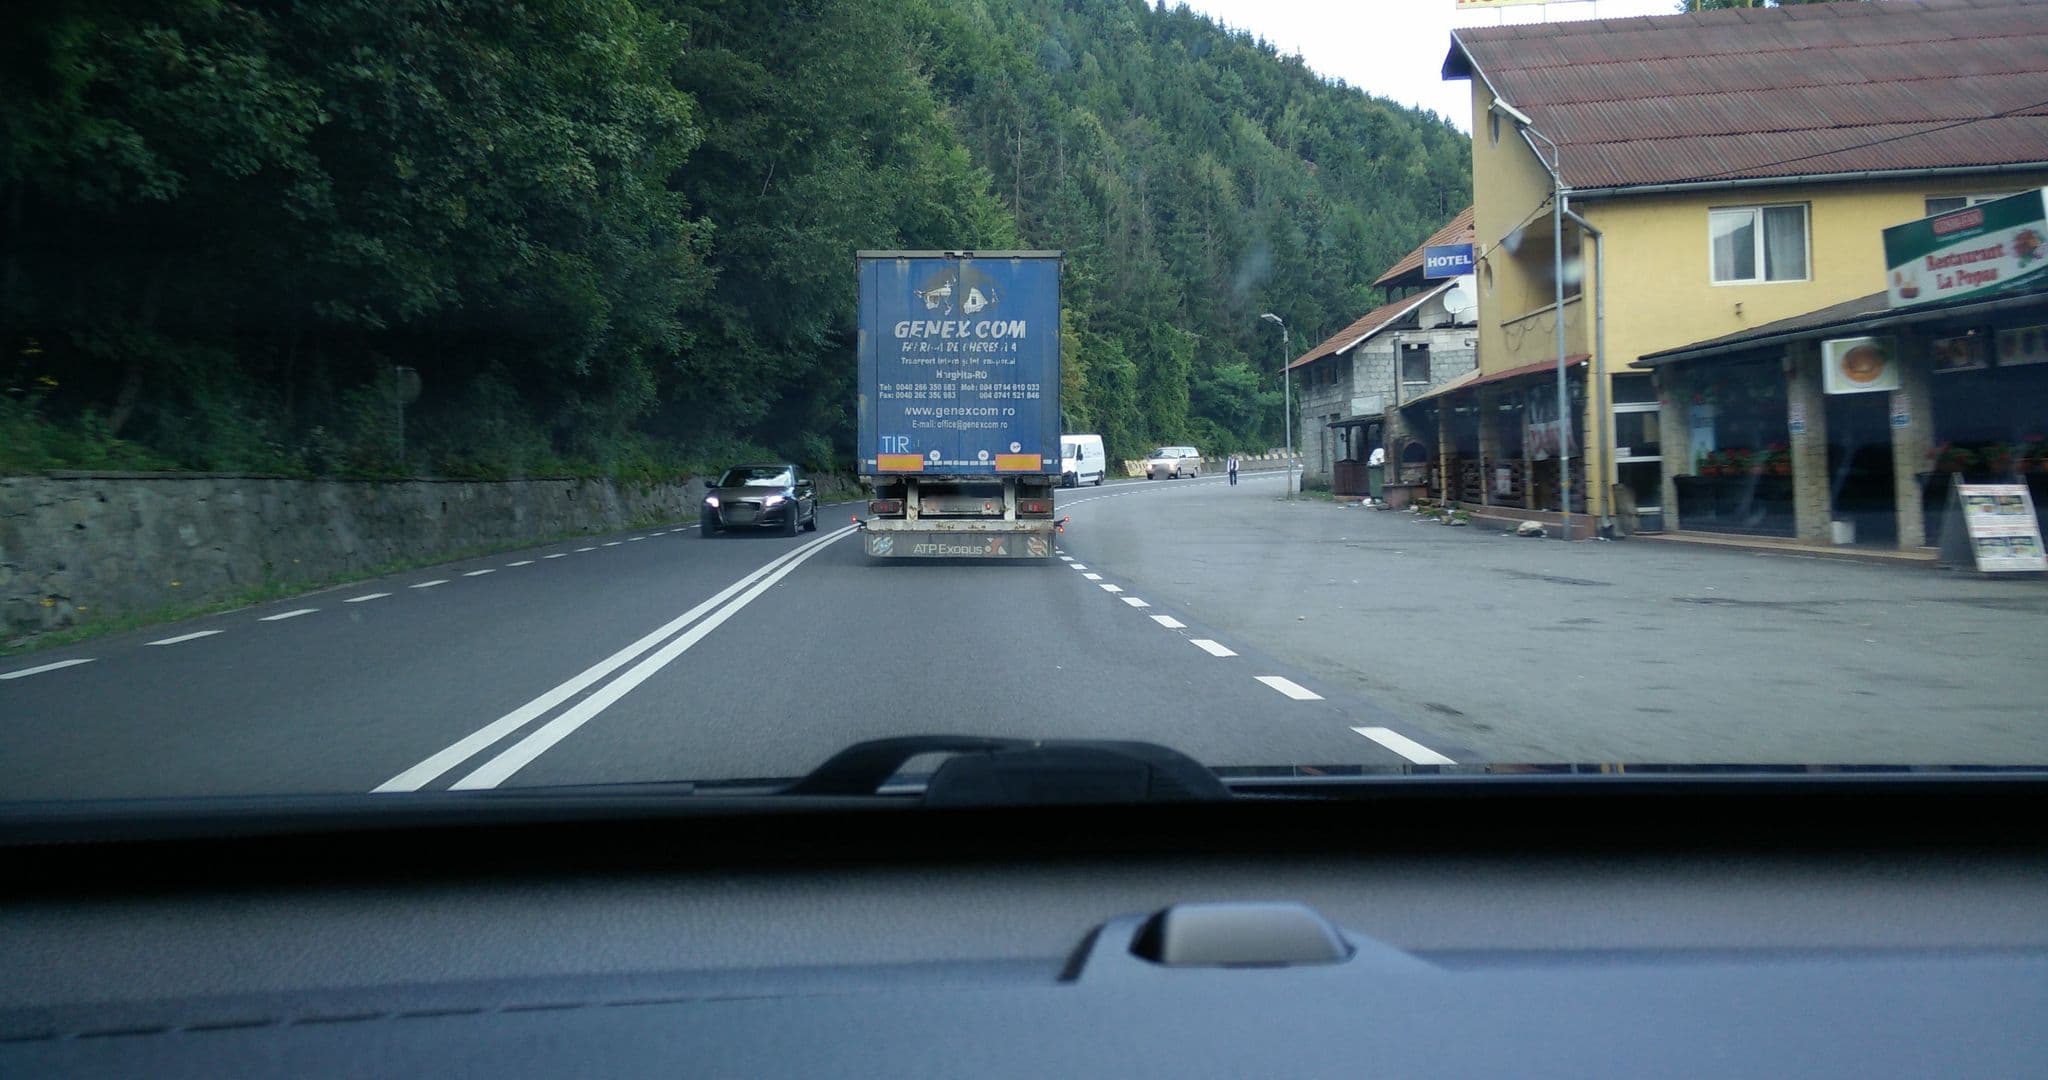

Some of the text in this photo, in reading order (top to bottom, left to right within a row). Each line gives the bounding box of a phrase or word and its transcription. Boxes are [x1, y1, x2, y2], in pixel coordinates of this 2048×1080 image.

[1427, 254, 1472, 268] HOTEL
[1936, 272, 1953, 290] La
[894, 319, 1026, 339] GENEX COM
[946, 341, 959, 352] DE
[895, 383, 913, 391] 0040
[979, 383, 993, 391] 004
[1026, 383, 1040, 391] 033
[879, 391, 894, 399] Fax:
[895, 391, 913, 399] 0040
[979, 391, 993, 399] 004
[993, 391, 1011, 399] 0741
[1012, 391, 1025, 399] 521
[904, 406, 1016, 418] www.genexcomro
[882, 435, 910, 453] TIR
[912, 543, 937, 555] ATP
